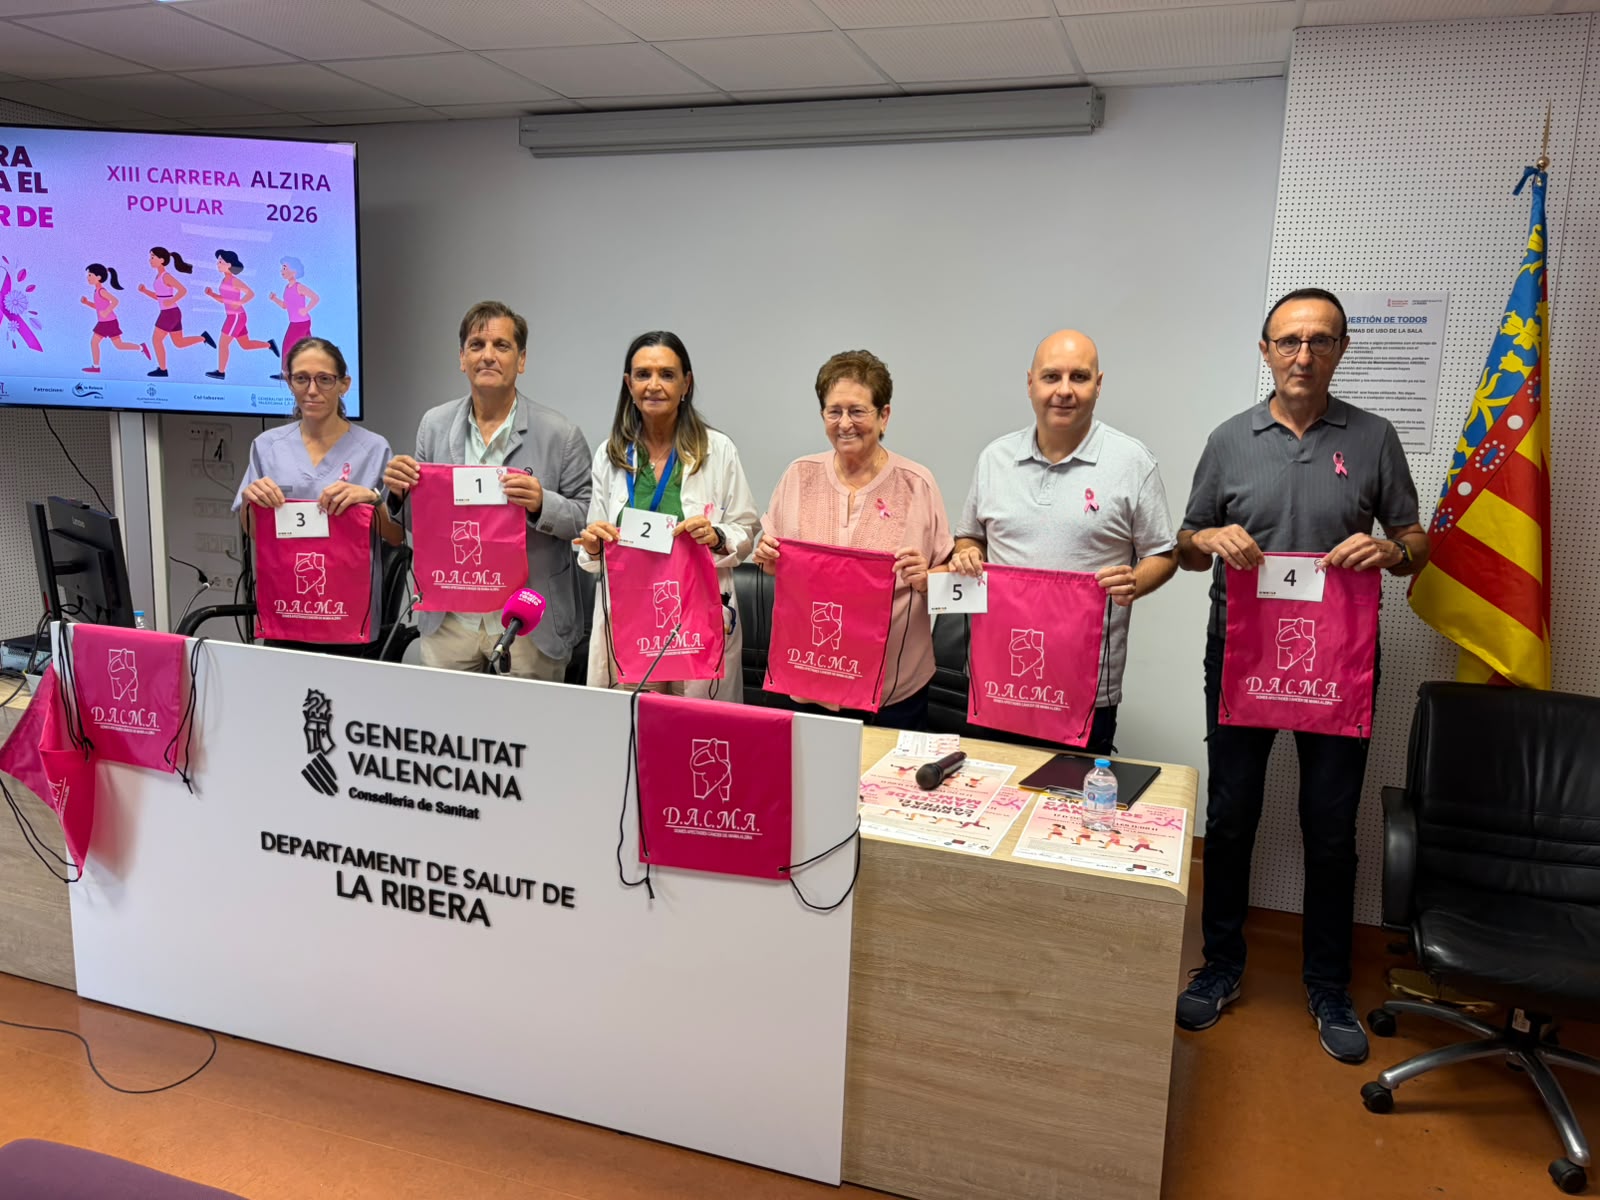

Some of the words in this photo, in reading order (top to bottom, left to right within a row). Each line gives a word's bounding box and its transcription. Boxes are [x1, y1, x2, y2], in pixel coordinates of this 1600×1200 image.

[17, 171, 49, 194] EL
[106, 164, 141, 183] XIII
[147, 166, 241, 188] CARRERA
[250, 169, 332, 193] ALZIRA
[126, 194, 224, 216] POPULAR
[265, 203, 319, 225] 2026
[16, 205, 54, 229] DE
[1383, 316, 1396, 324] DE
[1397, 316, 1428, 324] TODOS
[475, 478, 482, 493] 1
[295, 512, 306, 527] 3
[640, 522, 651, 539] 2
[1283, 569, 1297, 587] 4
[952, 584, 963, 601] 5
[1245, 676, 1341, 698] D.A.C.M.A.
[345, 720, 527, 769] GENERALITAT
[348, 751, 523, 801] VALENCIANA
[417, 798, 433, 812] de
[435, 801, 480, 820] Sanitat
[662, 806, 760, 832] D.A.C.M.A.
[260, 830, 421, 879] DEPARTAMENT
[426, 861, 458, 887] DE
[462, 868, 536, 901] SALUT
[542, 882, 576, 909] DE
[335, 870, 373, 903] LA
[381, 878, 491, 928] RIBERA
